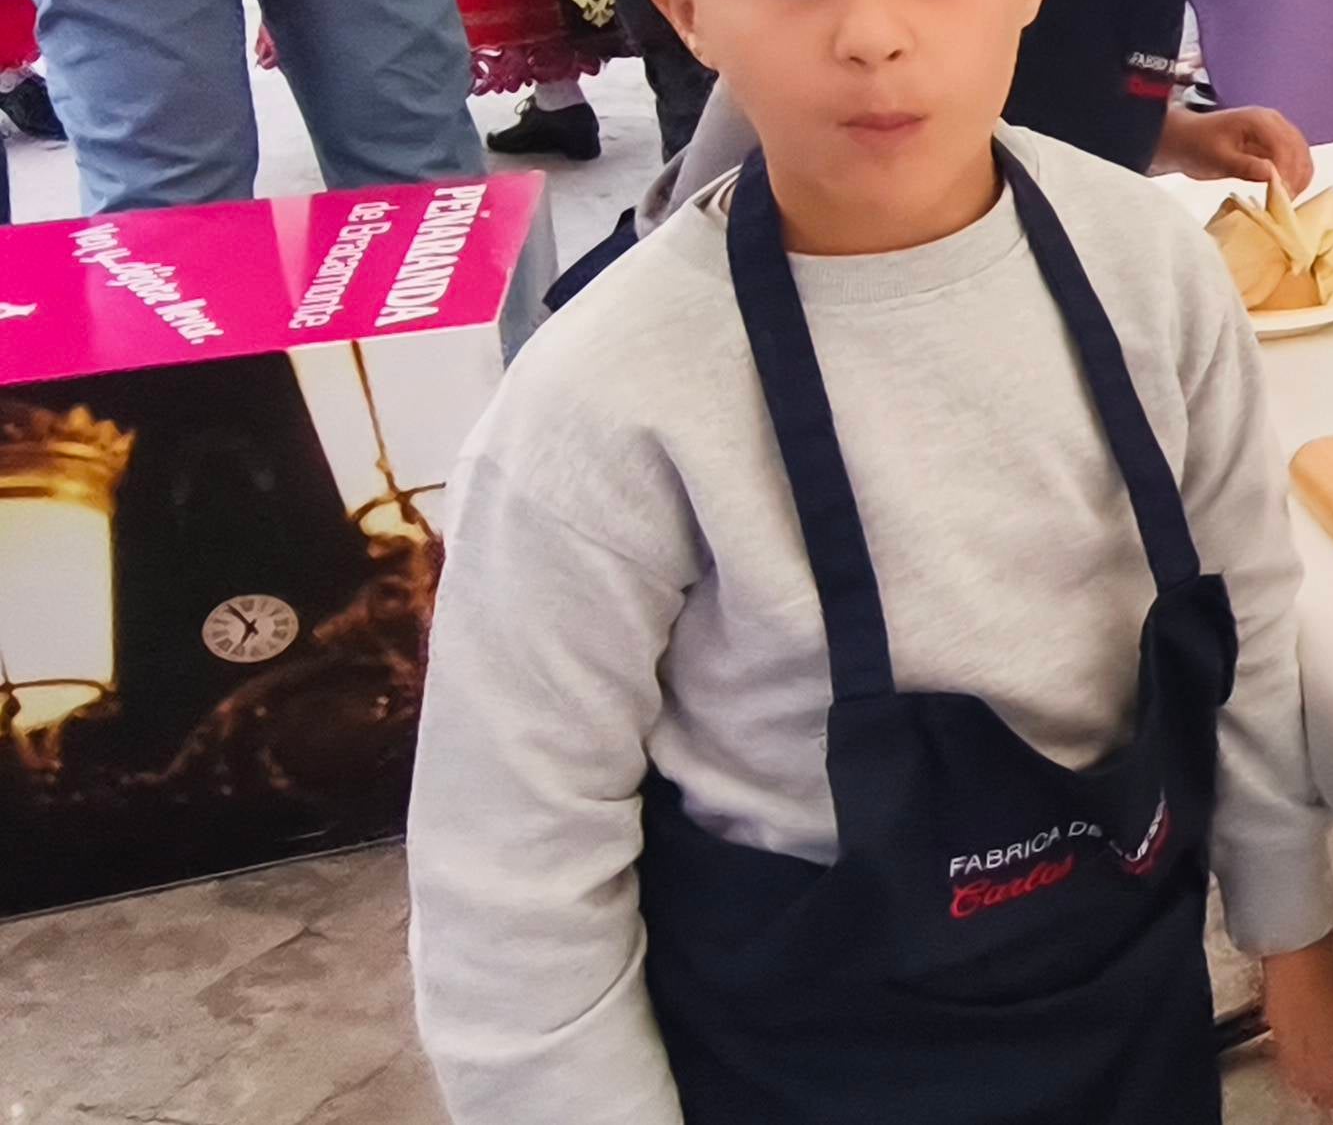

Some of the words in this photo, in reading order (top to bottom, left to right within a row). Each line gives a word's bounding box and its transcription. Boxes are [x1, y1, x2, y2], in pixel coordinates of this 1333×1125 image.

[346, 201, 400, 222] de
[287, 221, 393, 329] Bracamonte
[374, 184, 491, 328] PEÑARANDA
[949, 826, 1060, 877] FABRICA
